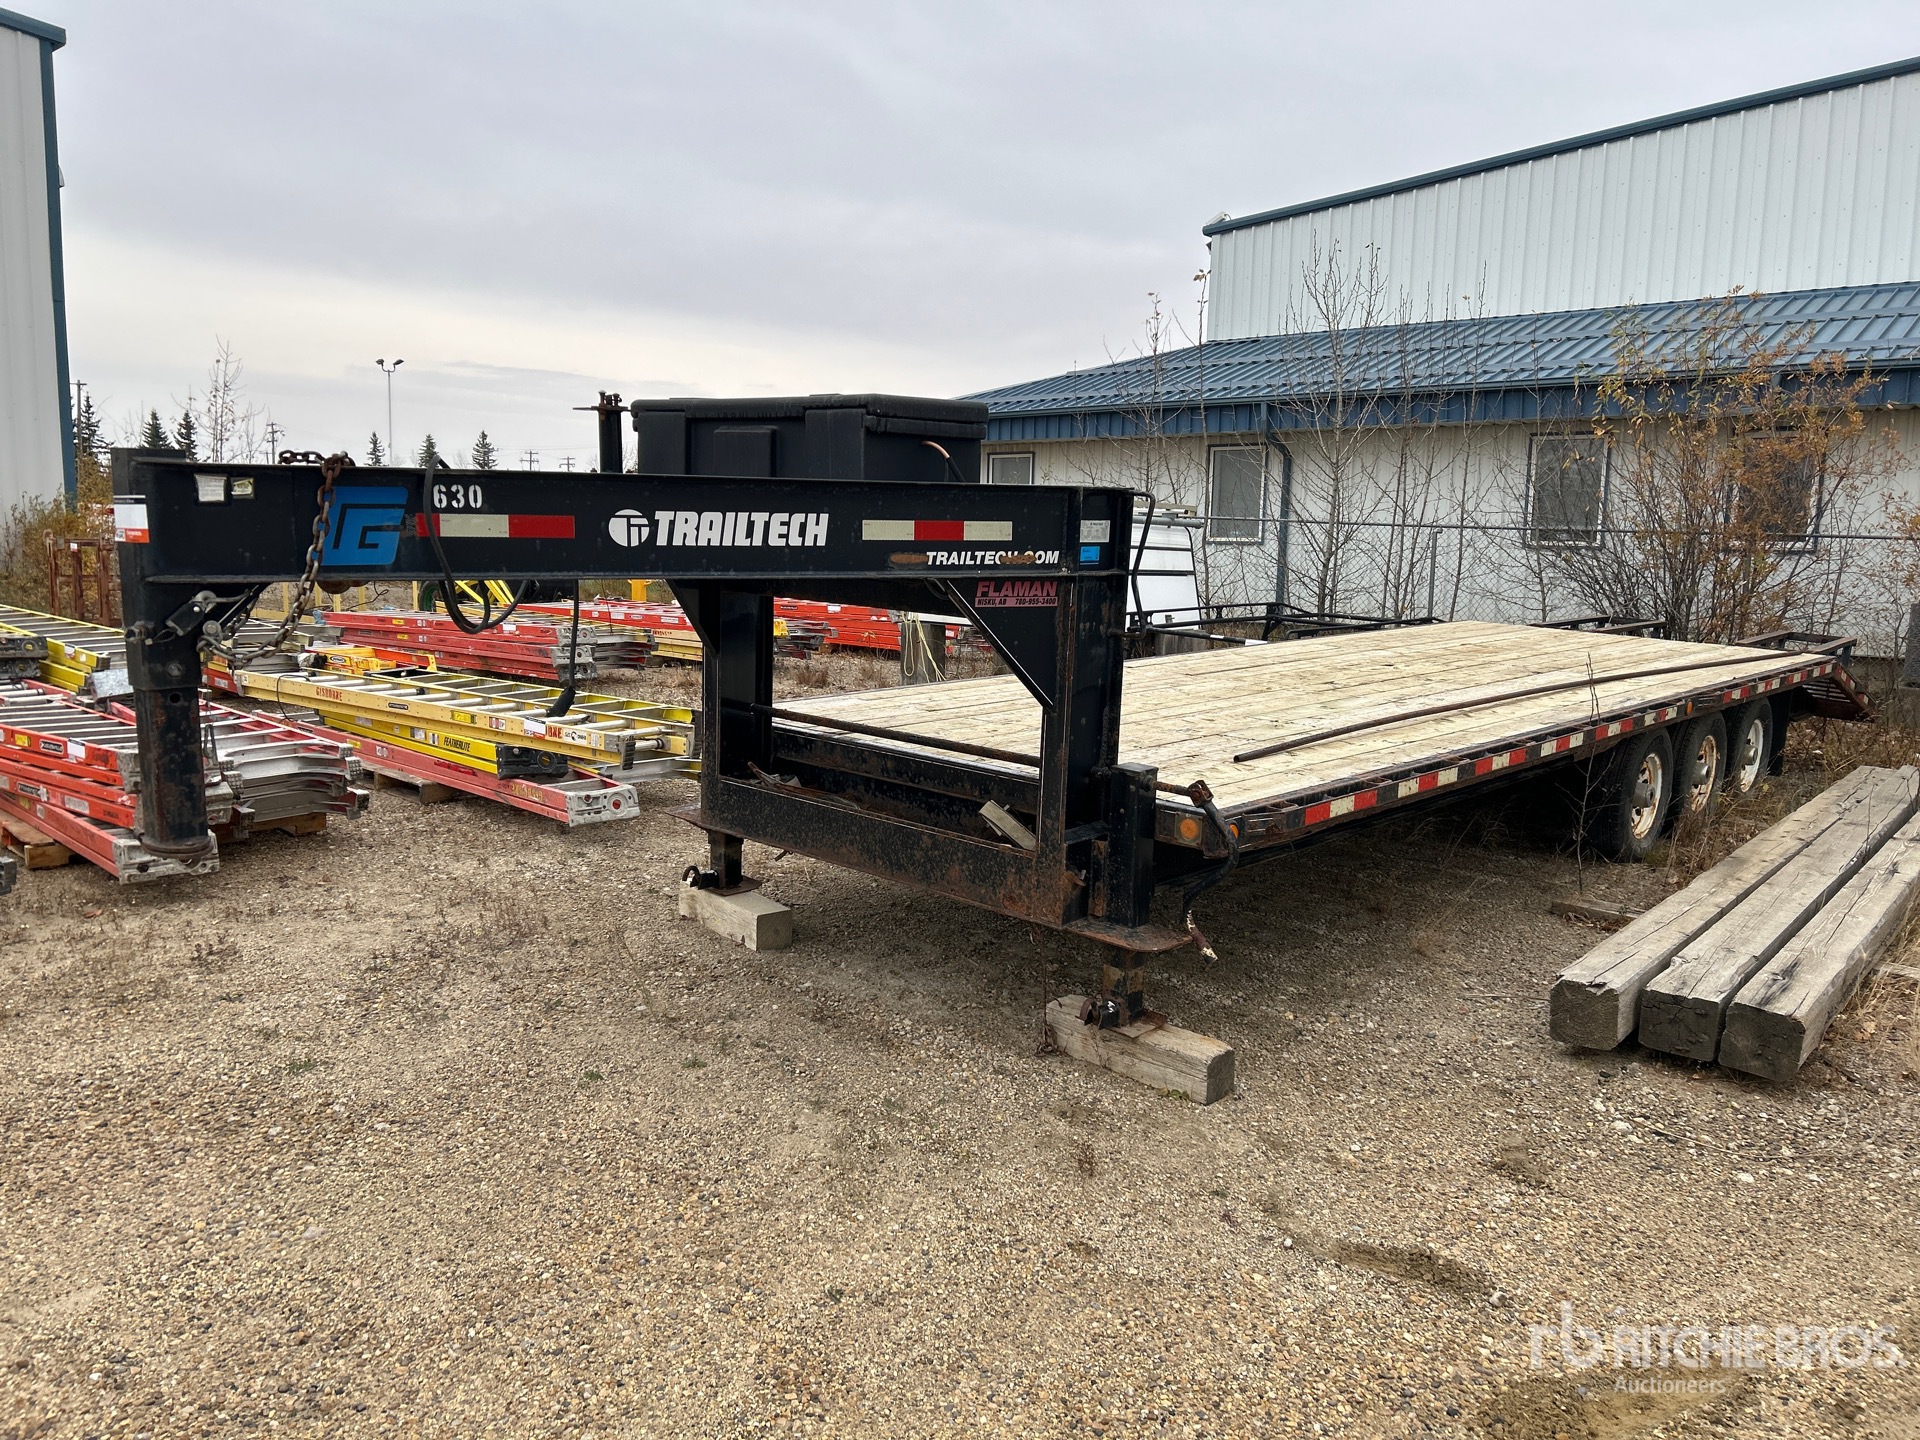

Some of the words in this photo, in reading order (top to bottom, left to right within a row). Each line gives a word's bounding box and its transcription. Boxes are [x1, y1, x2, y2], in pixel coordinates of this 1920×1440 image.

[433, 484, 483, 508] 630
[654, 510, 829, 546] TRAILTECH
[926, 550, 1060, 565] TRAILTECOM
[976, 581, 1058, 597] FLAMAN
